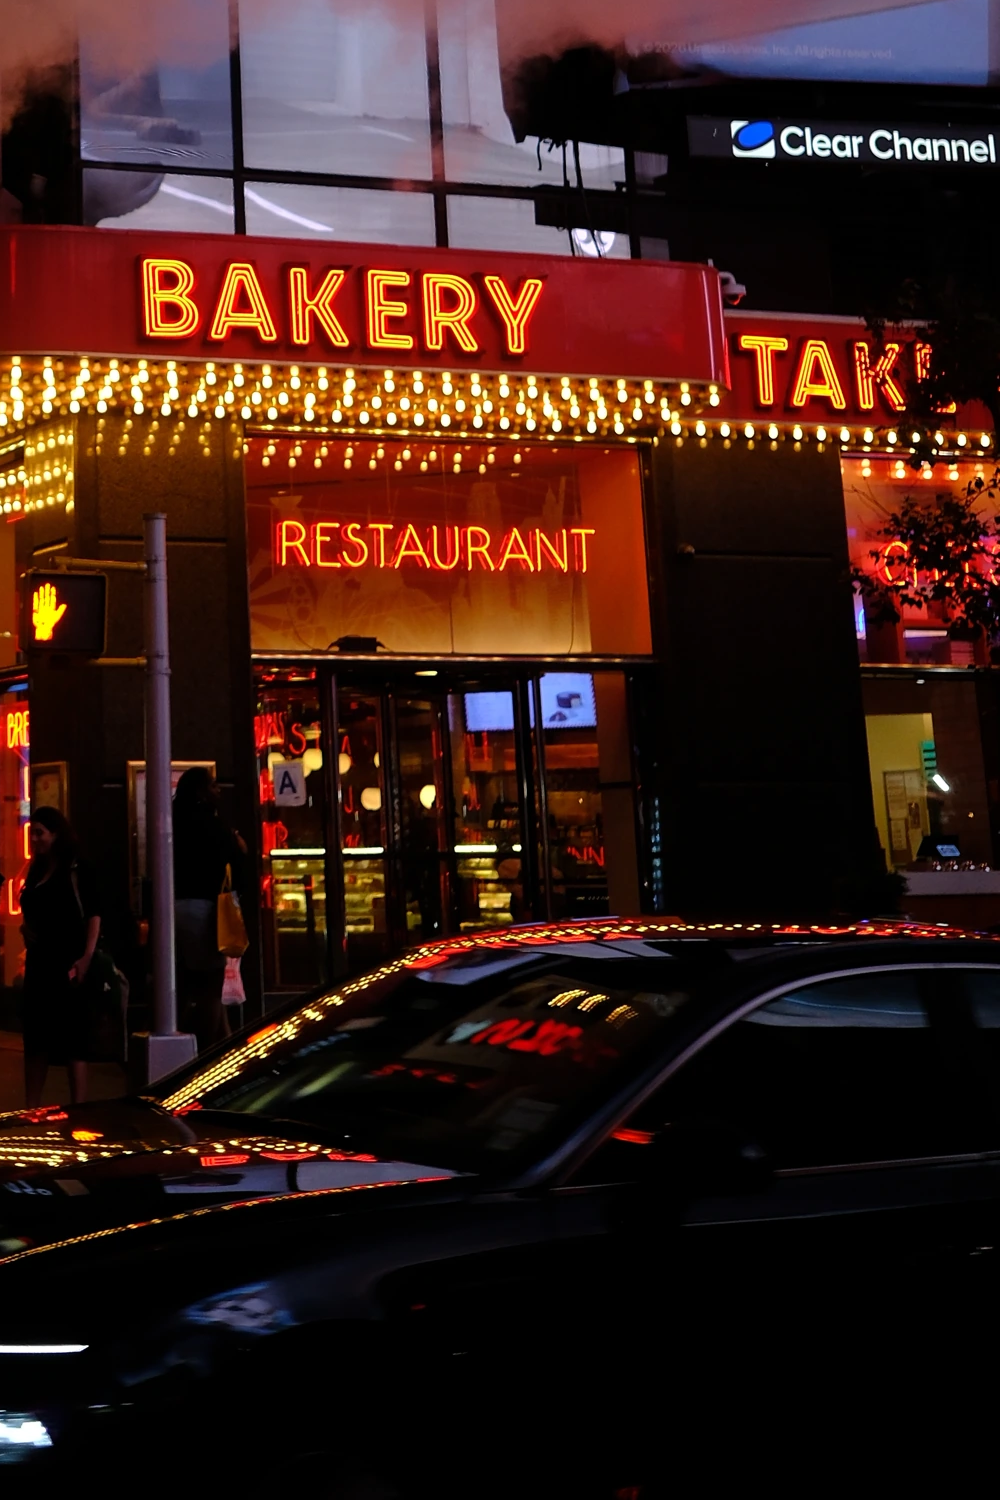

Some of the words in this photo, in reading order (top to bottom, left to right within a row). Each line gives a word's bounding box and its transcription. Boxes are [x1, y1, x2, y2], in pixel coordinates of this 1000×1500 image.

[779, 125, 864, 159] Clear
[868, 129, 997, 164] Channel
[141, 257, 545, 355] BAKERY
[280, 520, 596, 574] RESTAURANT
[279, 770, 297, 796] A
